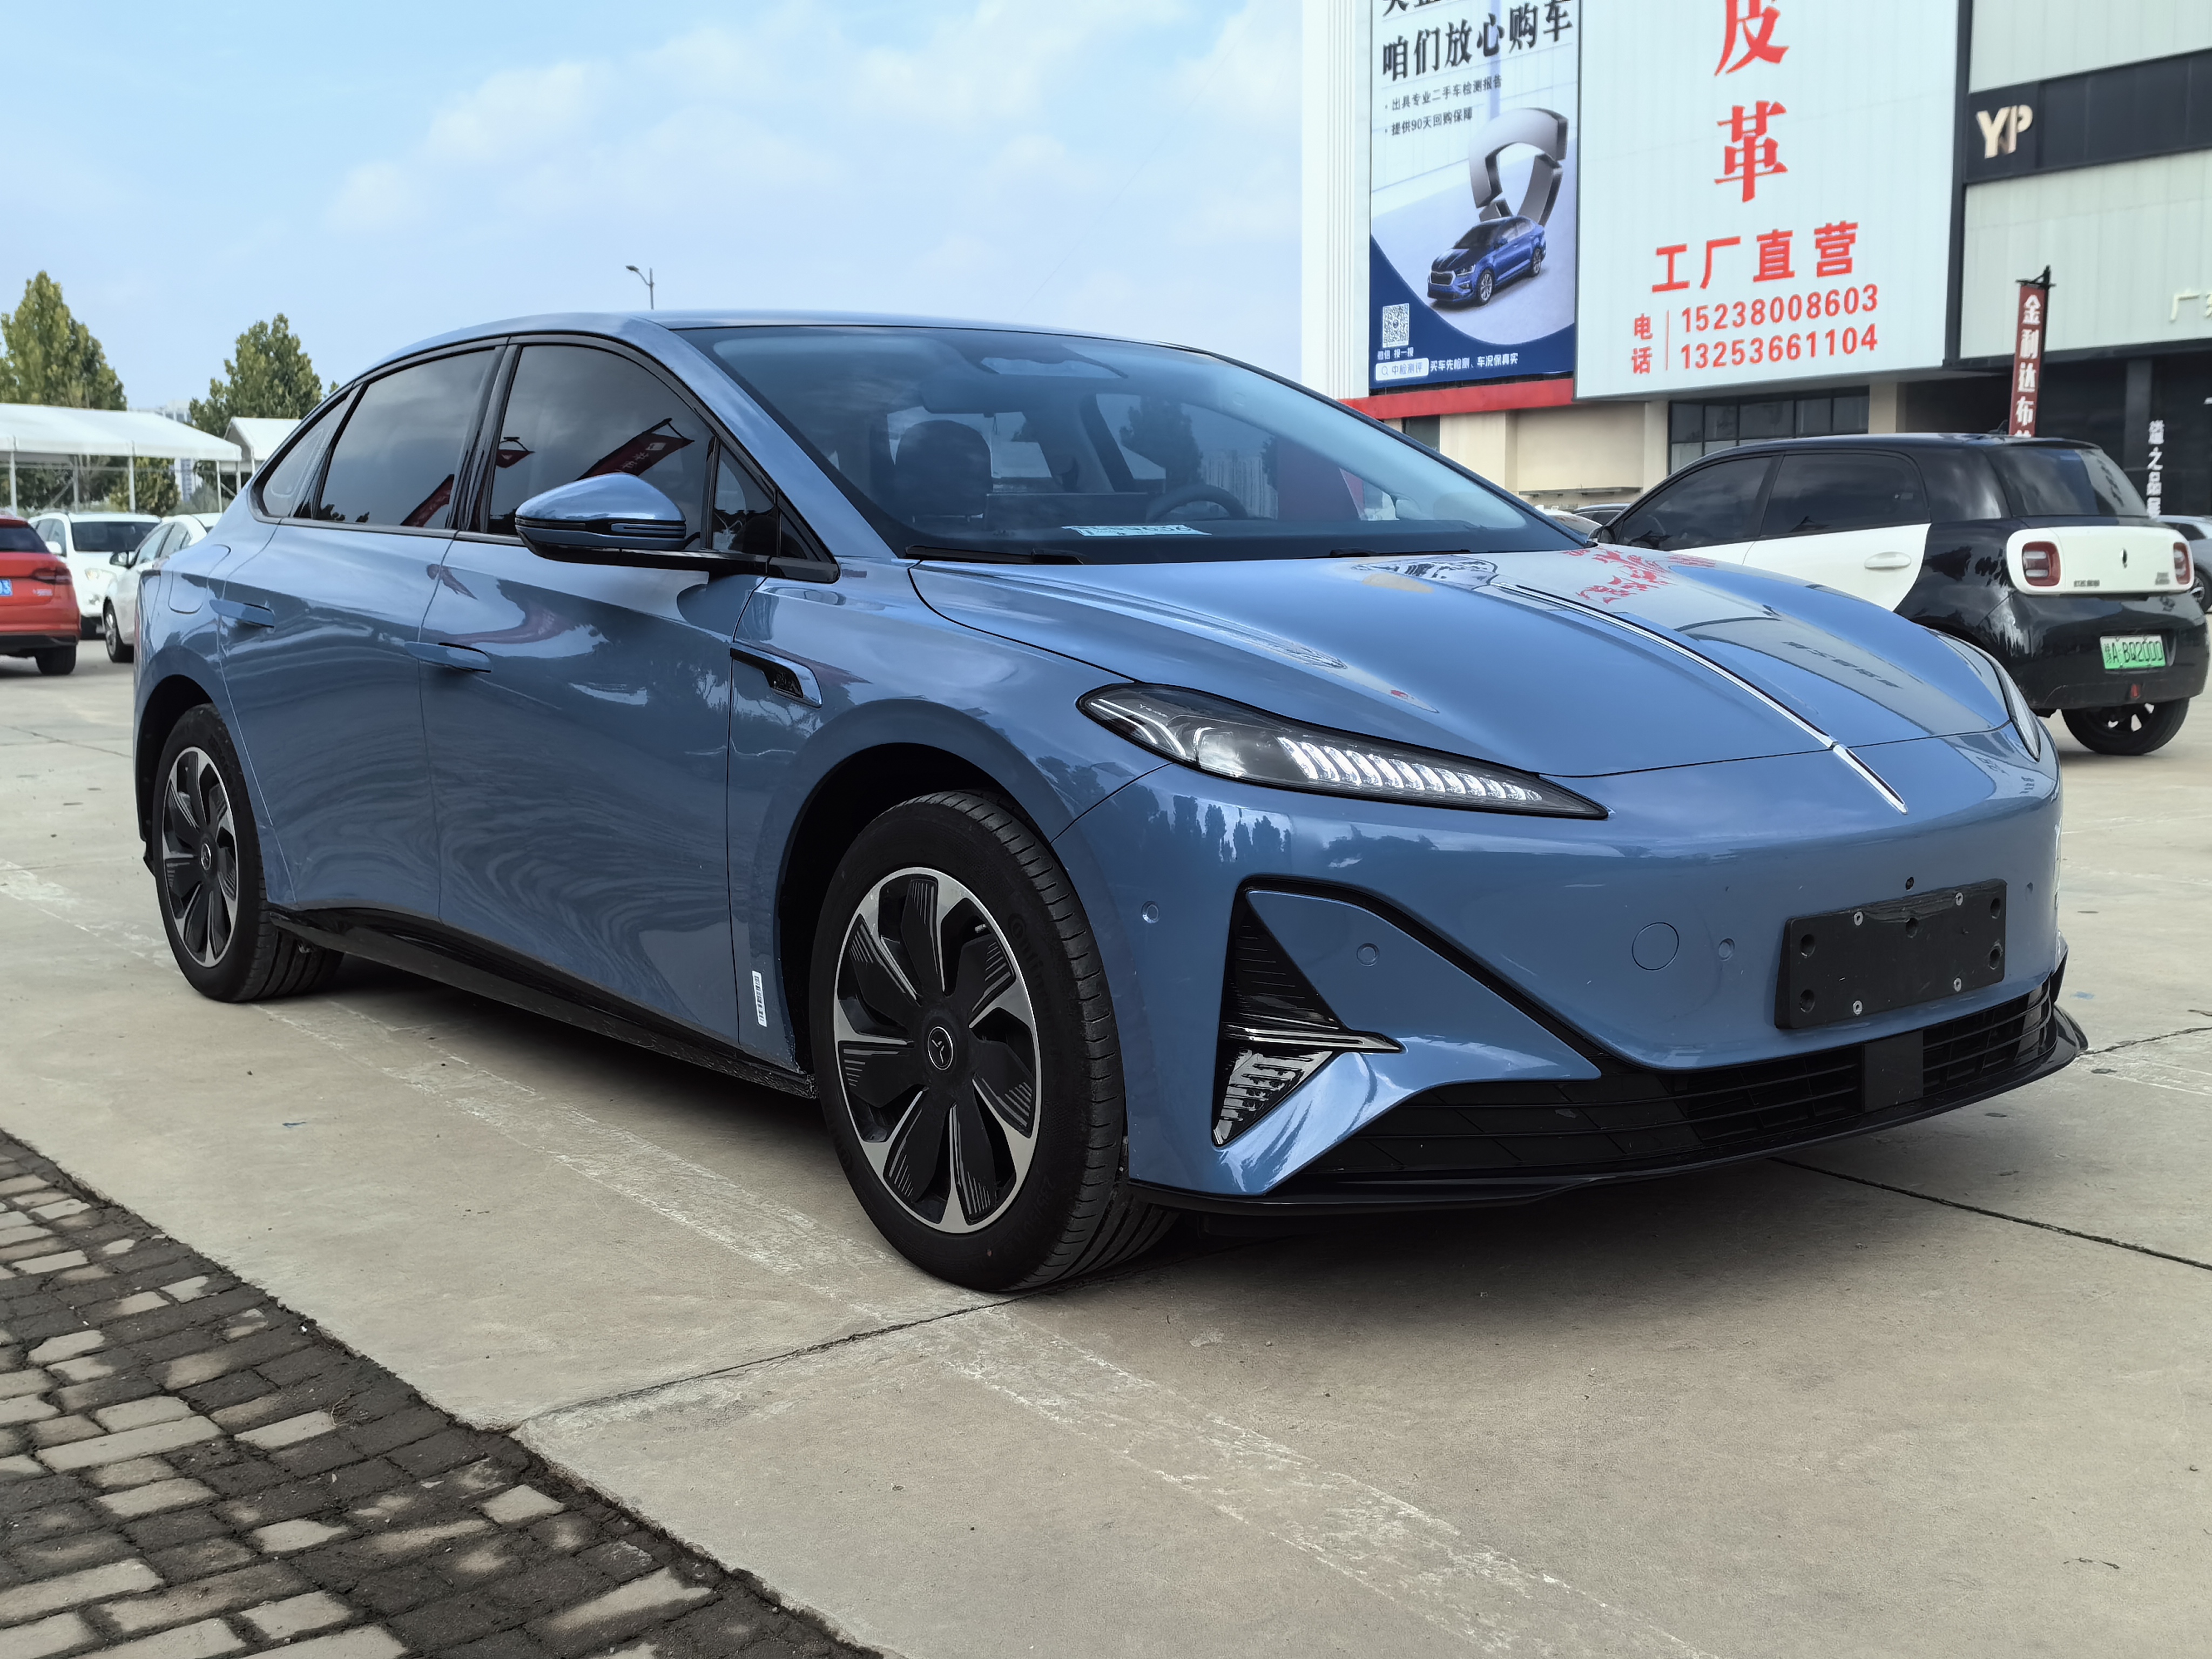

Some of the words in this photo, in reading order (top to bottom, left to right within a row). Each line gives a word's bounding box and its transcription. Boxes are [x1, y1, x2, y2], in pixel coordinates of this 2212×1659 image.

[1382, 0, 1572, 82] 咱们放心购车
[1392, 74, 1502, 111] 出具专业二手车检测报告
[1714, 0, 1789, 203] 皮革
[1391, 107, 1473, 136] 提供90天回购保障
[1976, 104, 2033, 159] YP
[1651, 221, 1859, 293] 工厂直营
[1682, 284, 1878, 333] 15238008603
[1631, 314, 1653, 374] 电话
[1681, 323, 1878, 370] 13253661104
[2015, 294, 2041, 437] 金利达布
